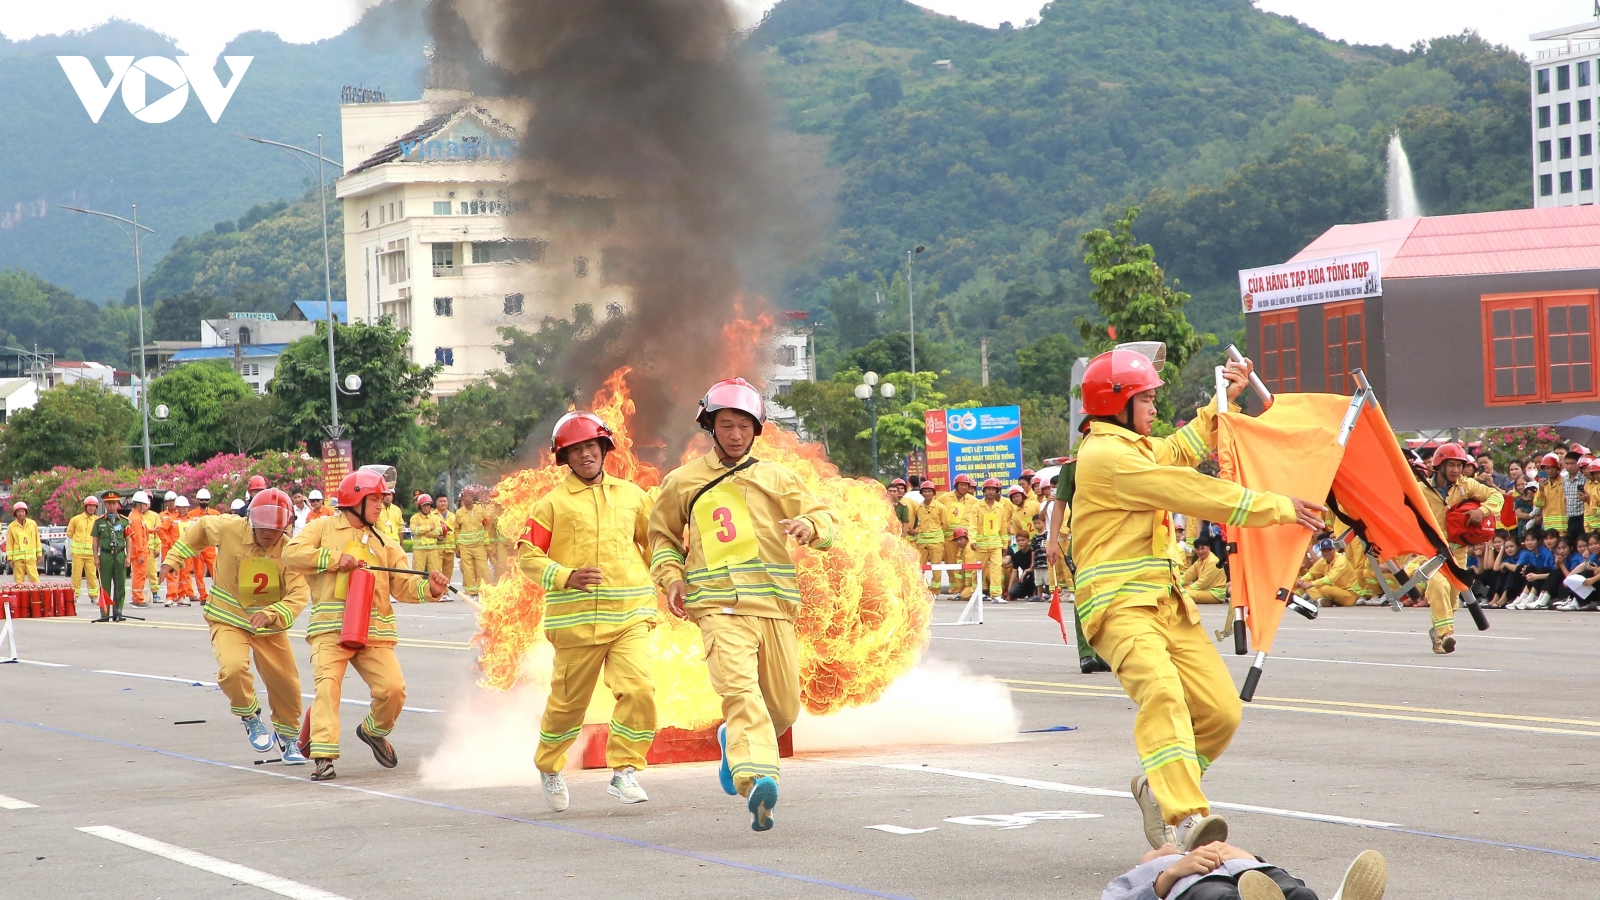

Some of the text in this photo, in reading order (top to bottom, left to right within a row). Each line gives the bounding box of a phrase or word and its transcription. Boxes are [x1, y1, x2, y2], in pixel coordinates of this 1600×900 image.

[1248, 258, 1369, 293] CỬA HÀNG TẠP HÓA TỔNG HỢP
[953, 508, 958, 516] 4
[713, 507, 737, 543] 3
[989, 520, 993, 529] 1
[1027, 523, 1034, 532] 2
[23, 536, 28, 545] 4
[253, 573, 269, 595] 2
